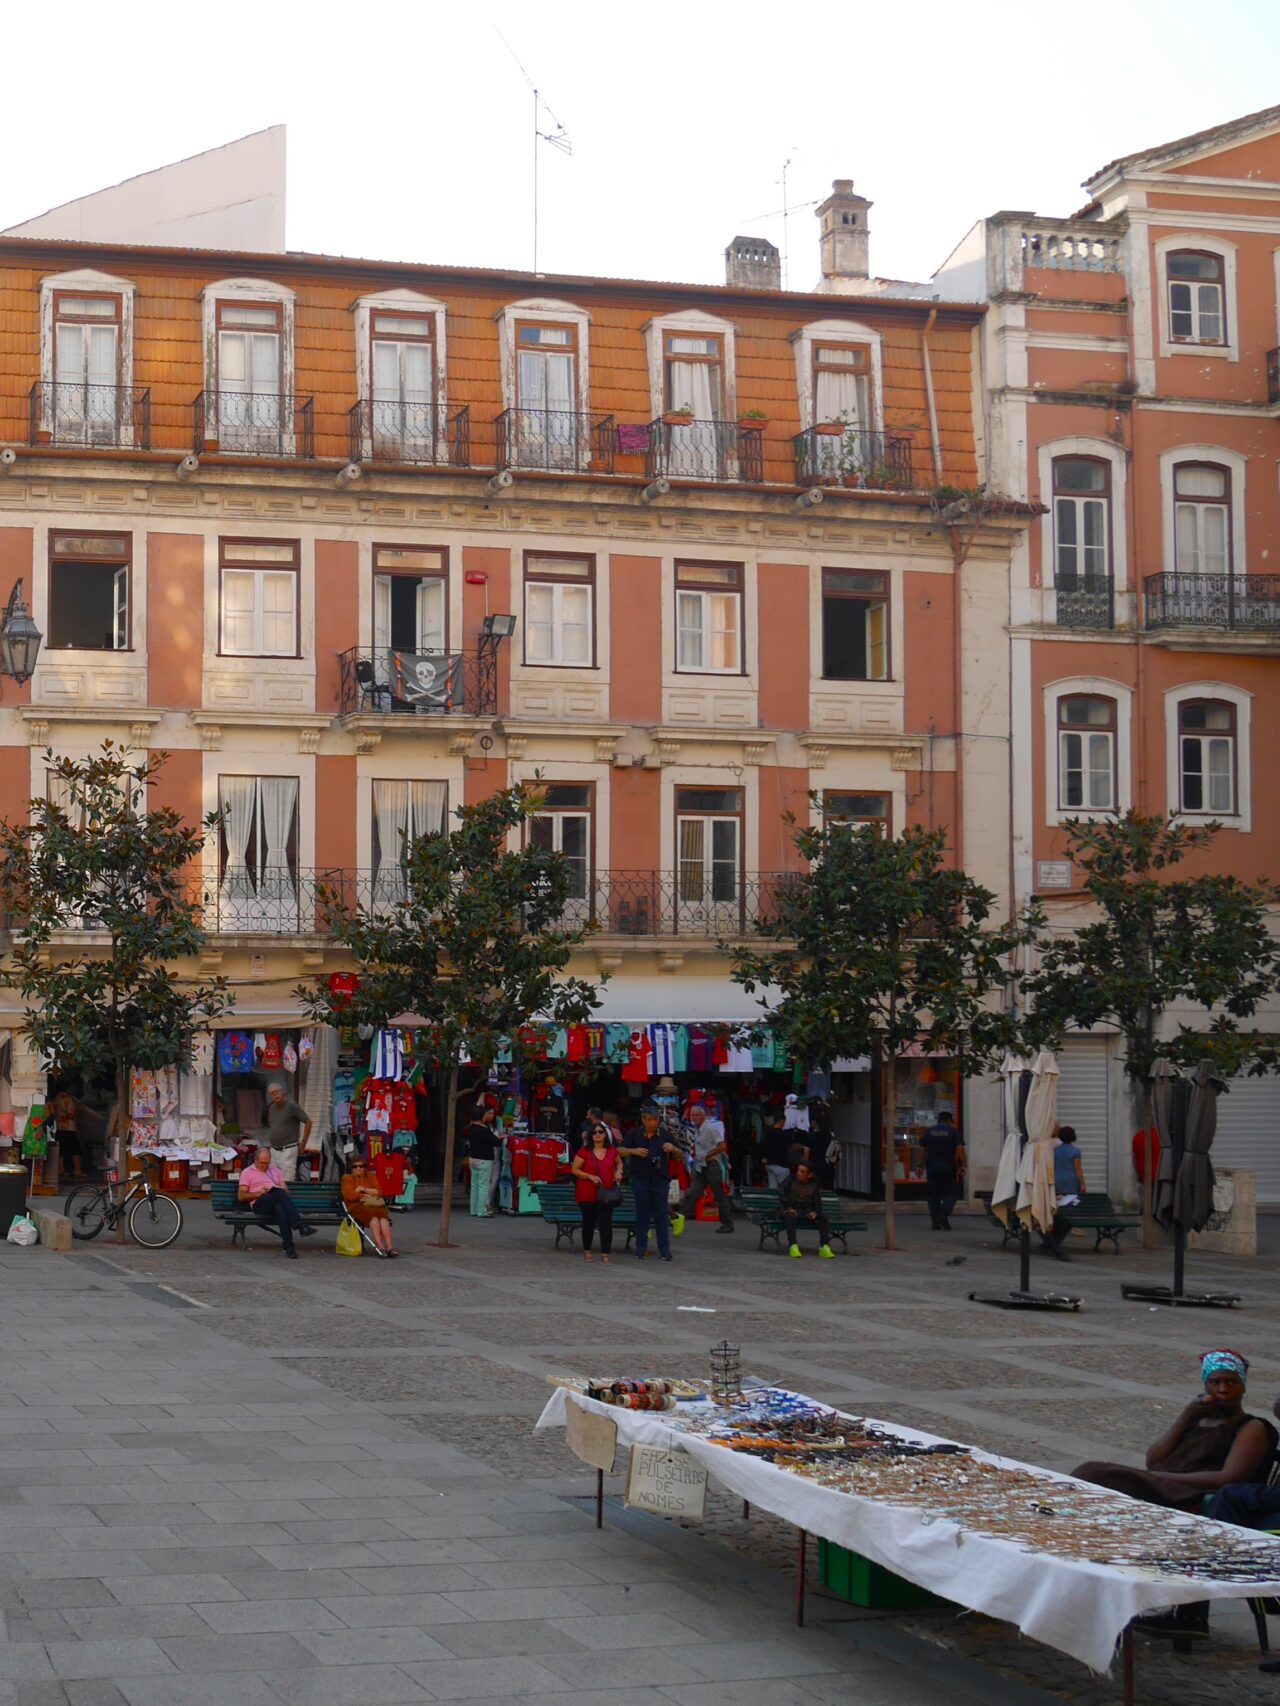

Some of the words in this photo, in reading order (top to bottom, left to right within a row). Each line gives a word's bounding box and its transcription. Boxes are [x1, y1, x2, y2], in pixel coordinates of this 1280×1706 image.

[370, 1141, 383, 1158] 10
[638, 1461, 704, 1485] PULSEIRAS
[656, 1480, 674, 1494] DE
[638, 1491, 685, 1511] NOMES
